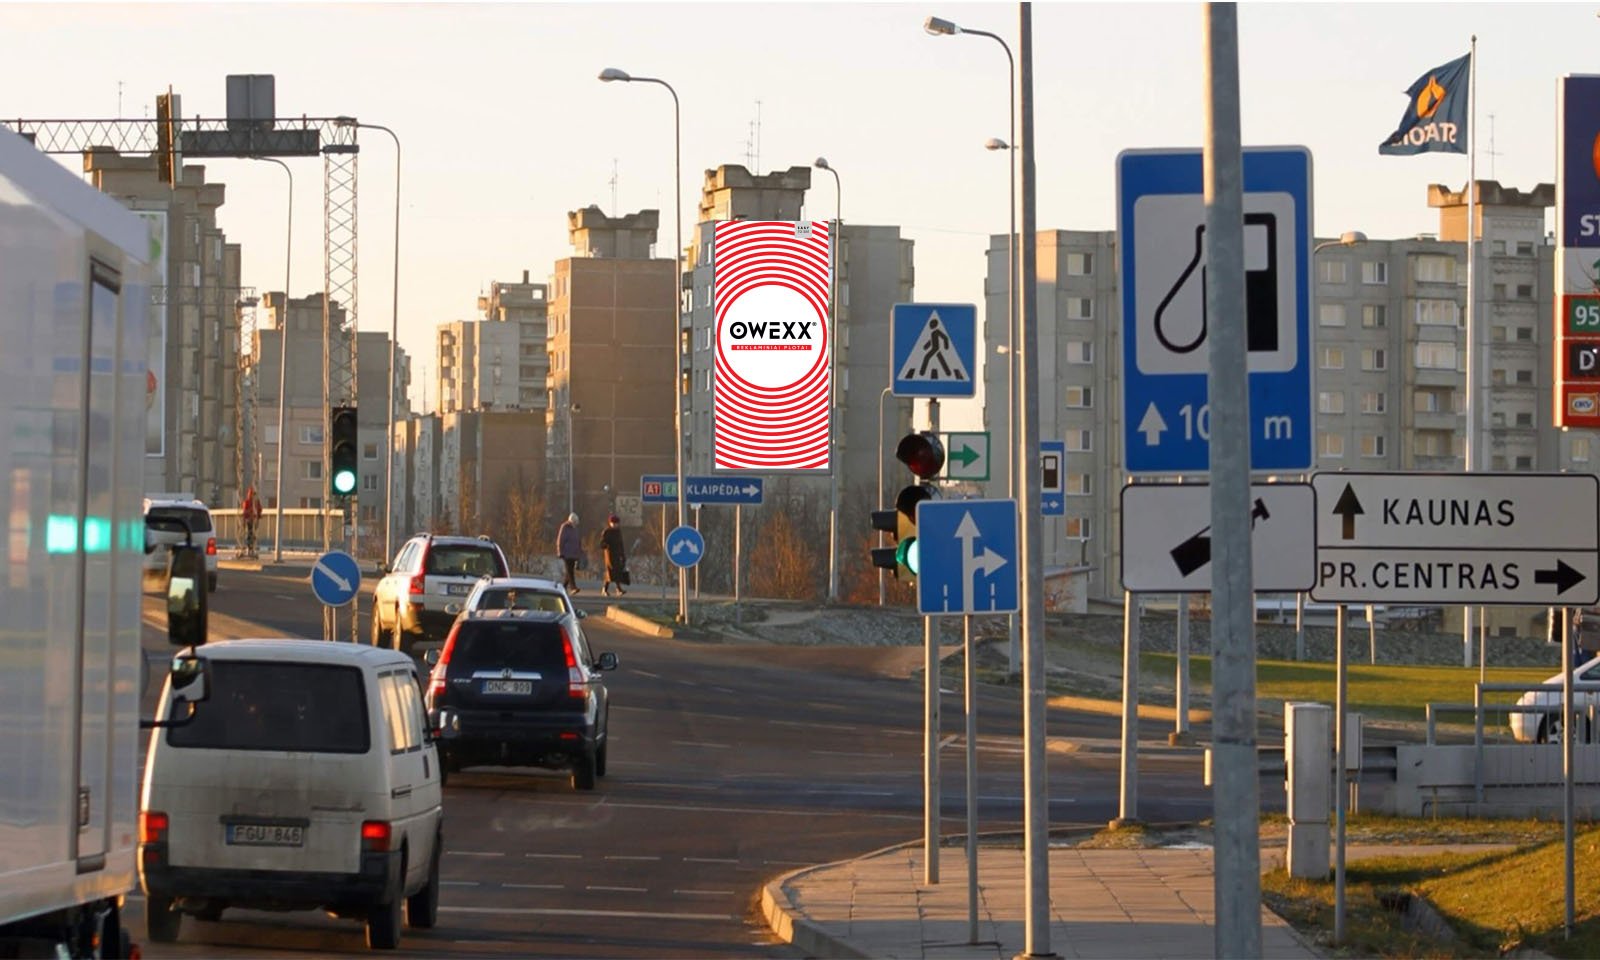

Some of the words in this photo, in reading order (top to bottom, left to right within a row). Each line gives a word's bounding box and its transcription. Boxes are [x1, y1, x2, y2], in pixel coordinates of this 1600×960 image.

[1575, 305, 1600, 326] 95
[1264, 415, 1292, 440] m
[647, 485, 659, 495] A1
[1383, 499, 1515, 526] KAUNAS
[1320, 562, 1520, 590] PR.CENTRAS
[235, 826, 265, 840] FGU
[274, 828, 300, 842] 846
